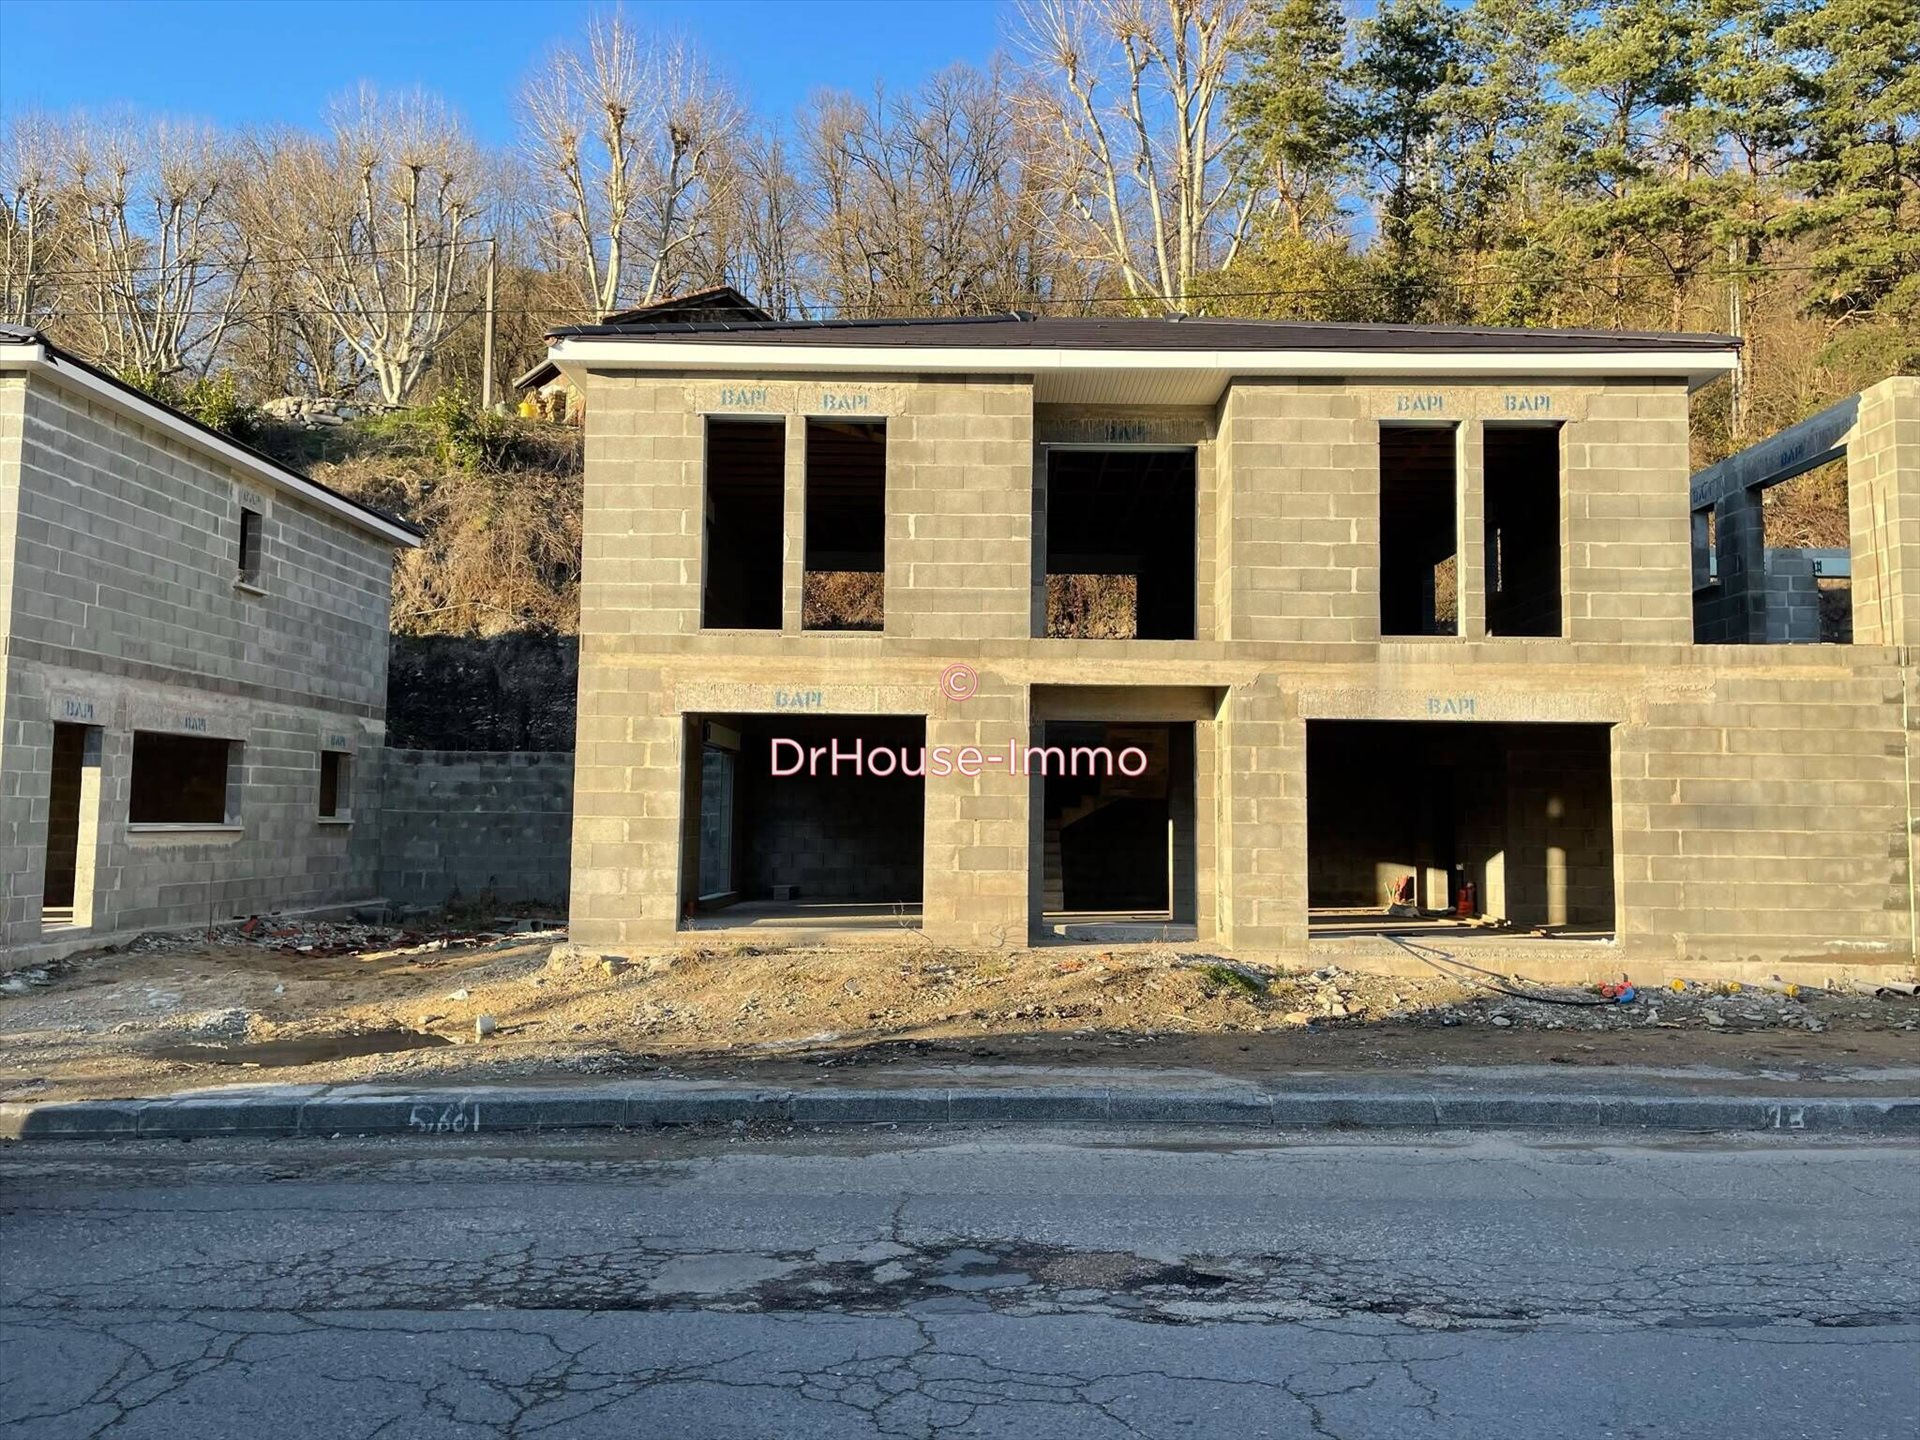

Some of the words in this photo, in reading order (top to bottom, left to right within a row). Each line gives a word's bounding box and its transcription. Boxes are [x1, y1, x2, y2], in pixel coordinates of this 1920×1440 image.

[720, 386, 767, 406] BAPI
[822, 394, 868, 409] BAPI
[1397, 396, 1443, 411] BAPI
[1505, 396, 1550, 411] BAPI
[775, 690, 823, 707] BAPI
[1428, 698, 1475, 714] BAPI
[66, 700, 94, 719] BAPI
